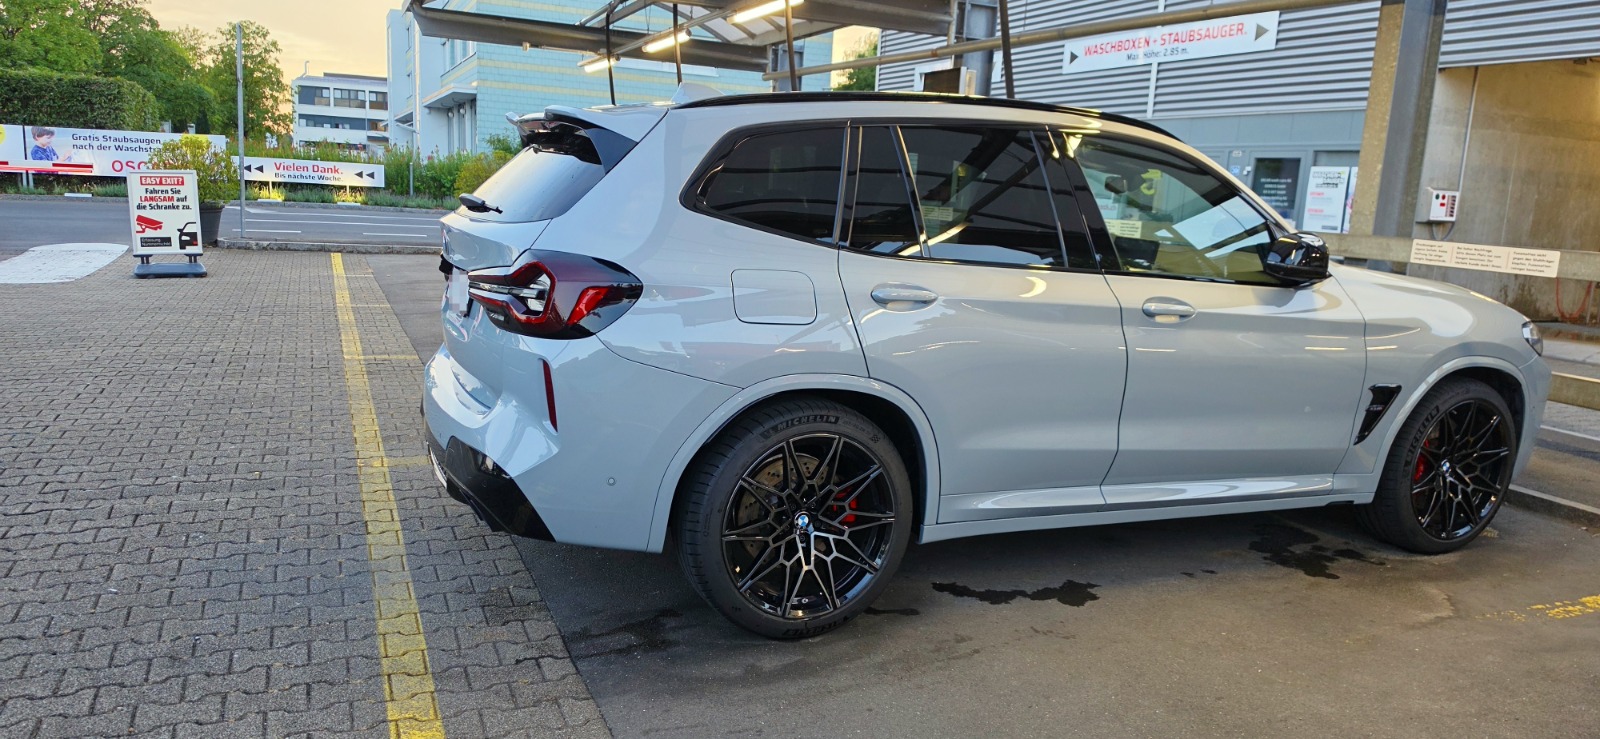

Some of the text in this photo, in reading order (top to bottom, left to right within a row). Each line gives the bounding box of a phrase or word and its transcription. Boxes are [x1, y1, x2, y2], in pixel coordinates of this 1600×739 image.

[1084, 37, 1151, 56] WASCHBOXEN
[1160, 22, 1248, 46] STAUBSAUGER.
[72, 133, 161, 145] Gratis Staubsaugen
[72, 143, 94, 151] nach
[96, 143, 112, 151] der
[274, 162, 344, 175] Vielen Dank.
[141, 176, 183, 185] EASY EXIT?
[777, 415, 837, 431] MICHELIN
